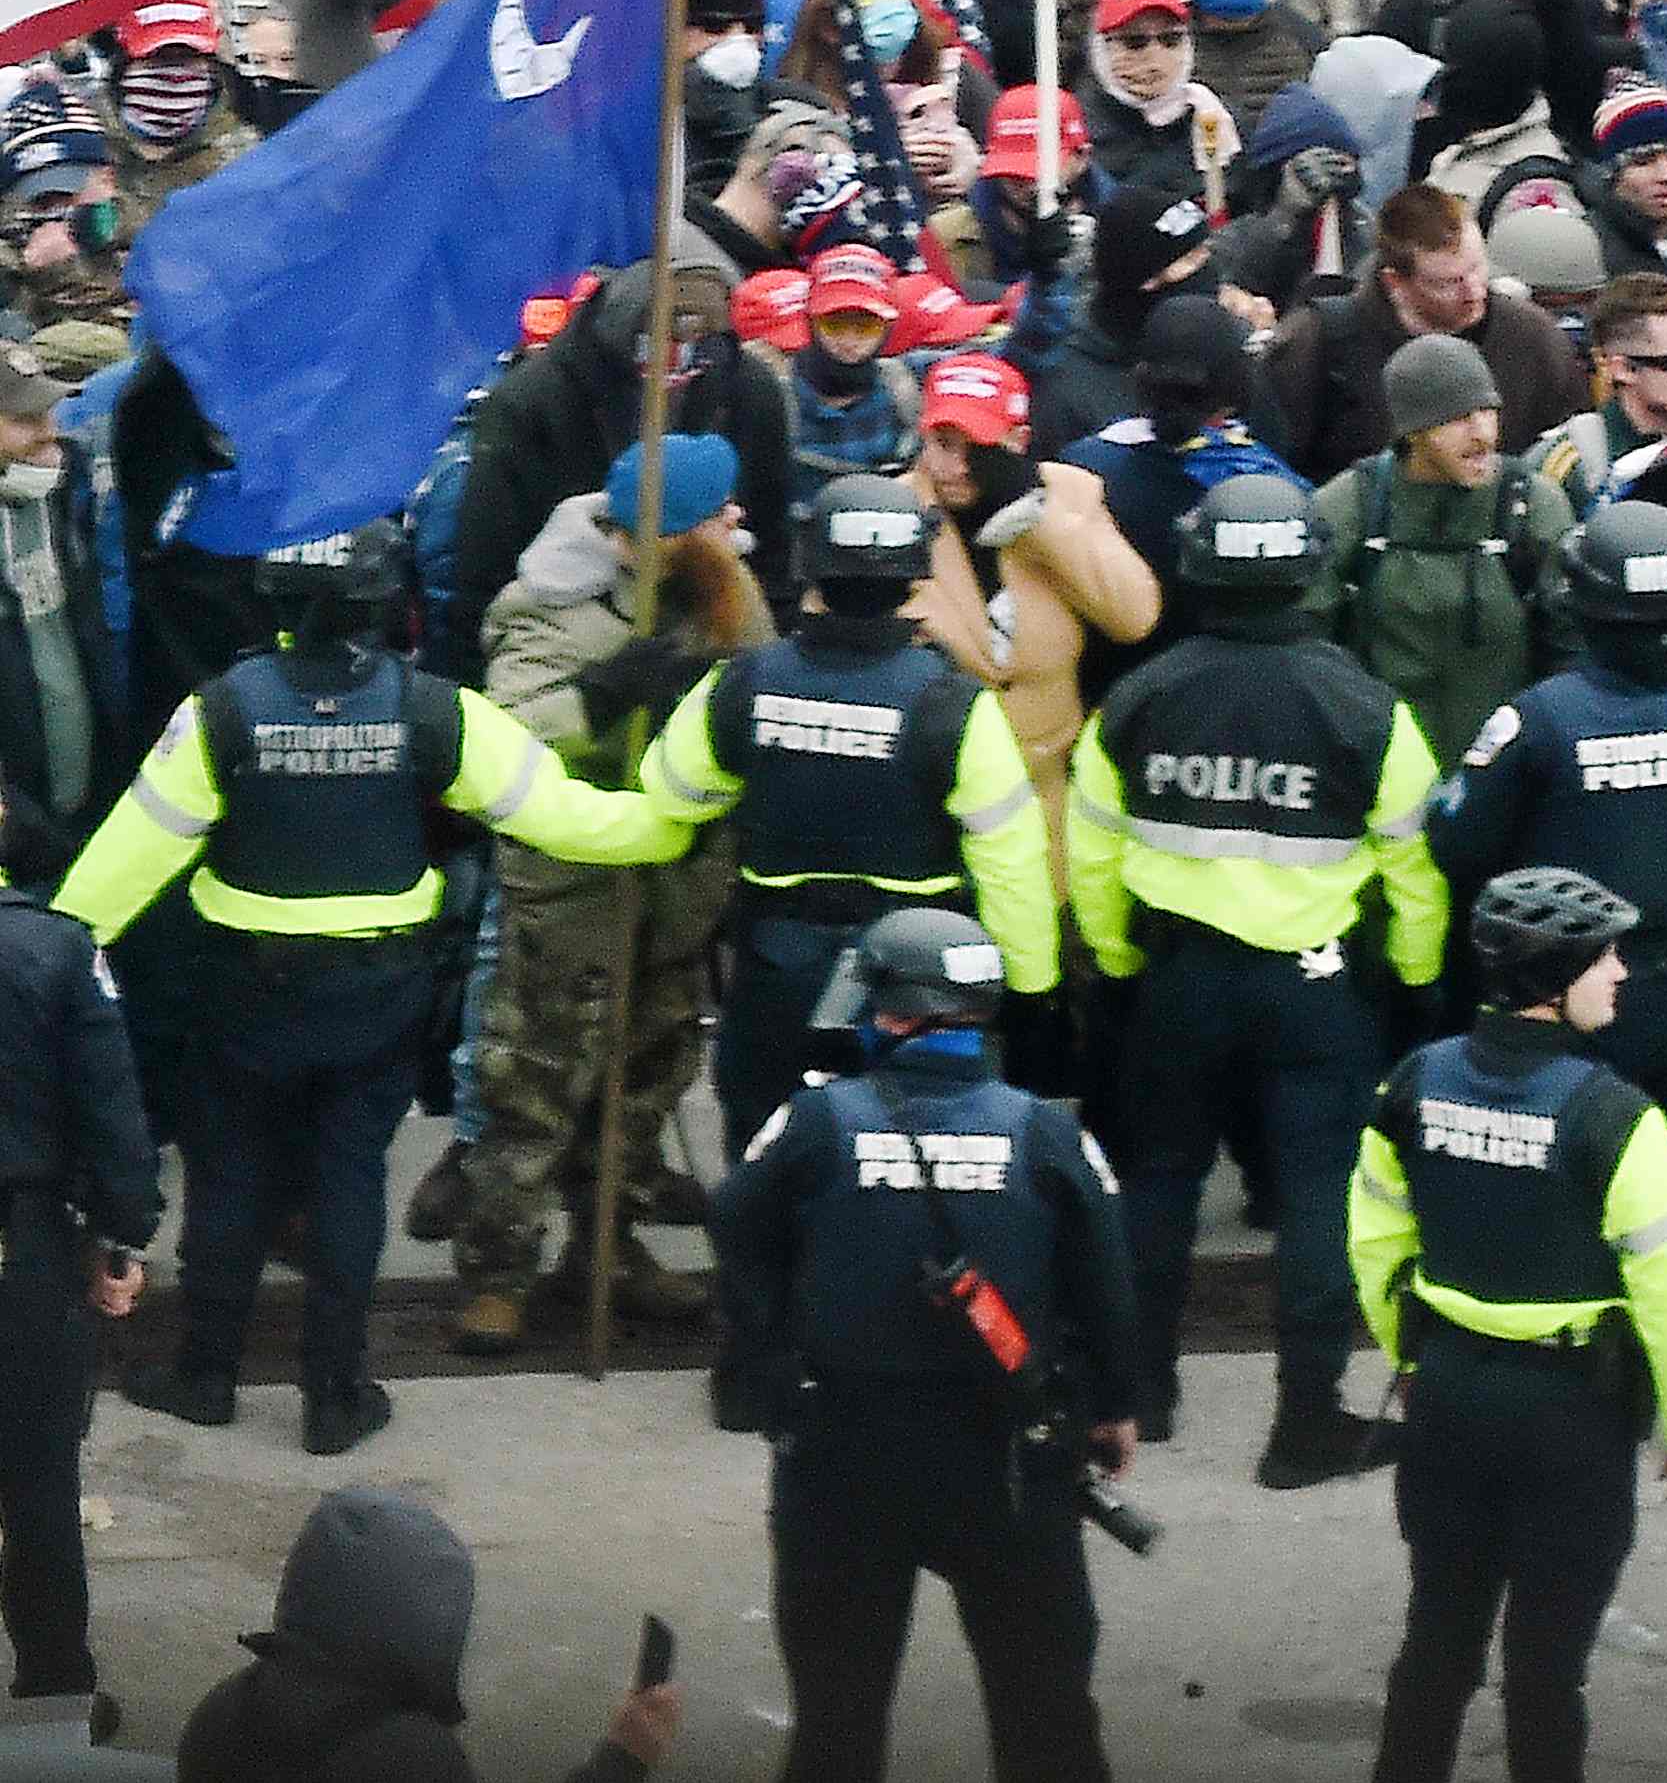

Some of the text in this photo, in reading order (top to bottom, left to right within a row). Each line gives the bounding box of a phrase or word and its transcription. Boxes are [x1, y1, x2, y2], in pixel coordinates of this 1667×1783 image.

[257, 748, 401, 776] POLICE
[1144, 752, 1319, 811] POLICE
[1422, 1126, 1549, 1171] POLICE
